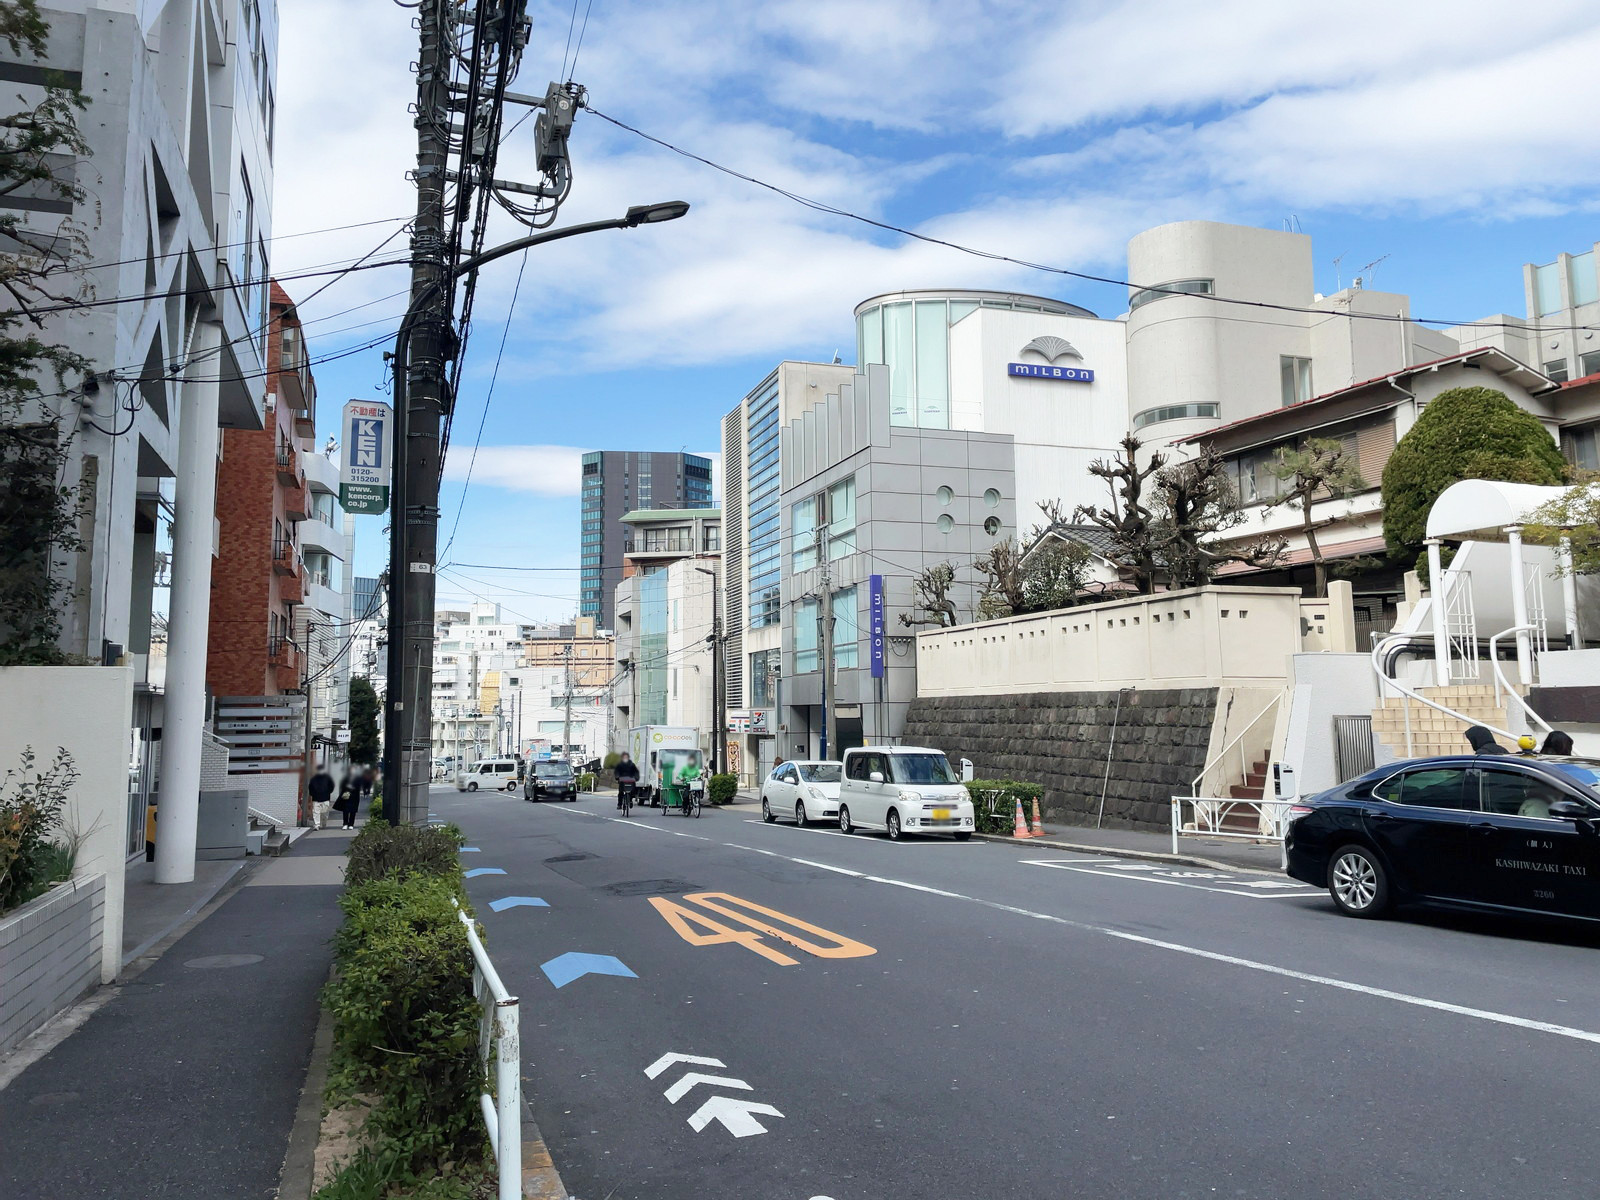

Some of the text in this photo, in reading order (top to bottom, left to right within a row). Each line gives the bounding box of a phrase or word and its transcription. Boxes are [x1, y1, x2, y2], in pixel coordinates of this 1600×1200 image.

[350, 405, 386, 417] 不動産は
[356, 420, 376, 467] KEN
[350, 475, 380, 483] 315200
[348, 485, 372, 493] www.
[347, 492, 383, 502] kencorp.
[347, 500, 368, 508] co.jp
[1495, 858, 1587, 876] KASHIWAZAKI TAXI
[647, 892, 878, 967] 40
